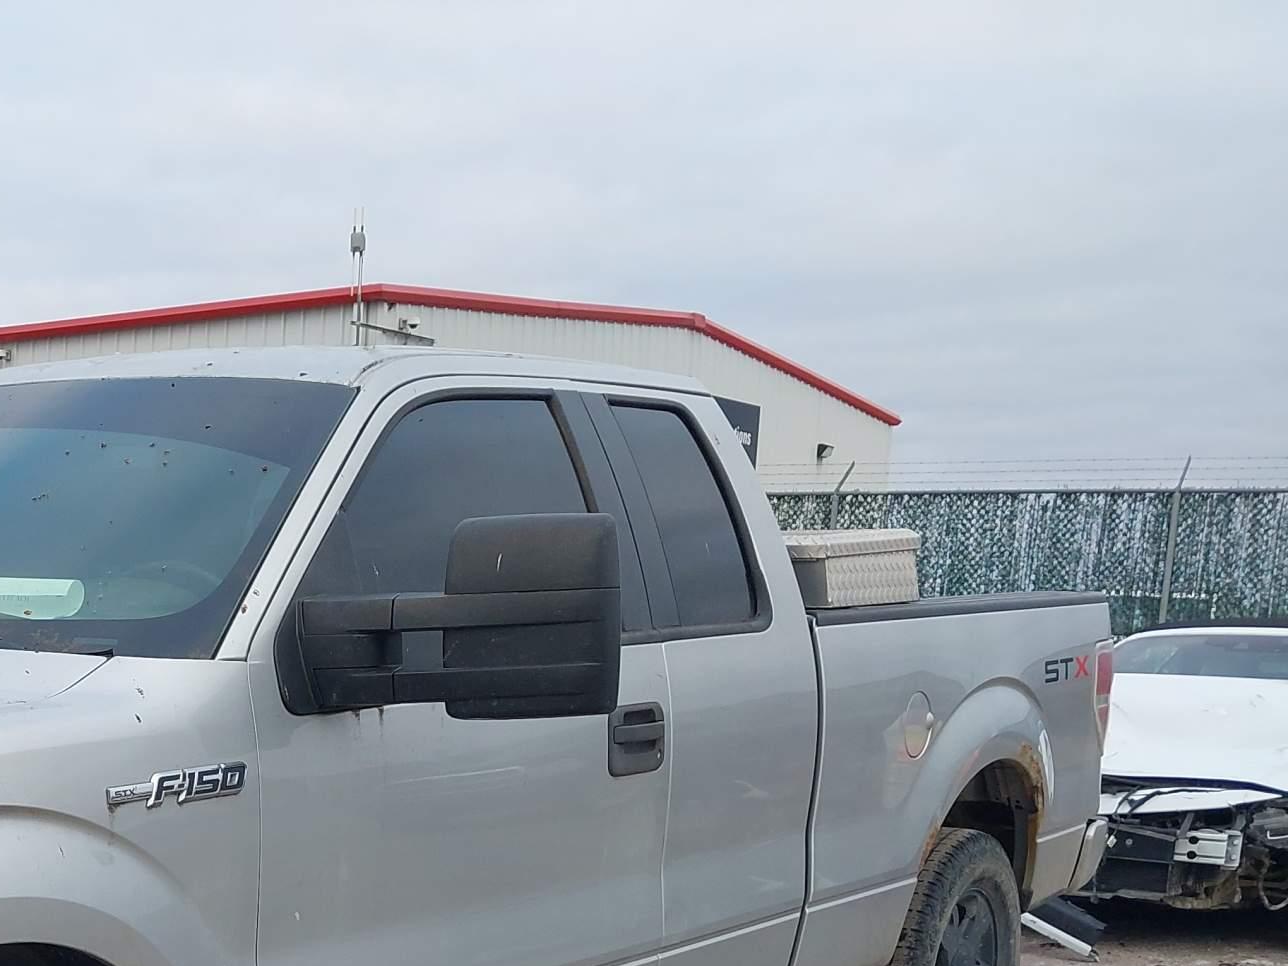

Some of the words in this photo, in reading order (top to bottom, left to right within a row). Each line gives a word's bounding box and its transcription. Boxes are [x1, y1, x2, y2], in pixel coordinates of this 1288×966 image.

[1044, 655, 1089, 684] STX
[114, 787, 137, 800] STX
[149, 763, 247, 806] F-150
